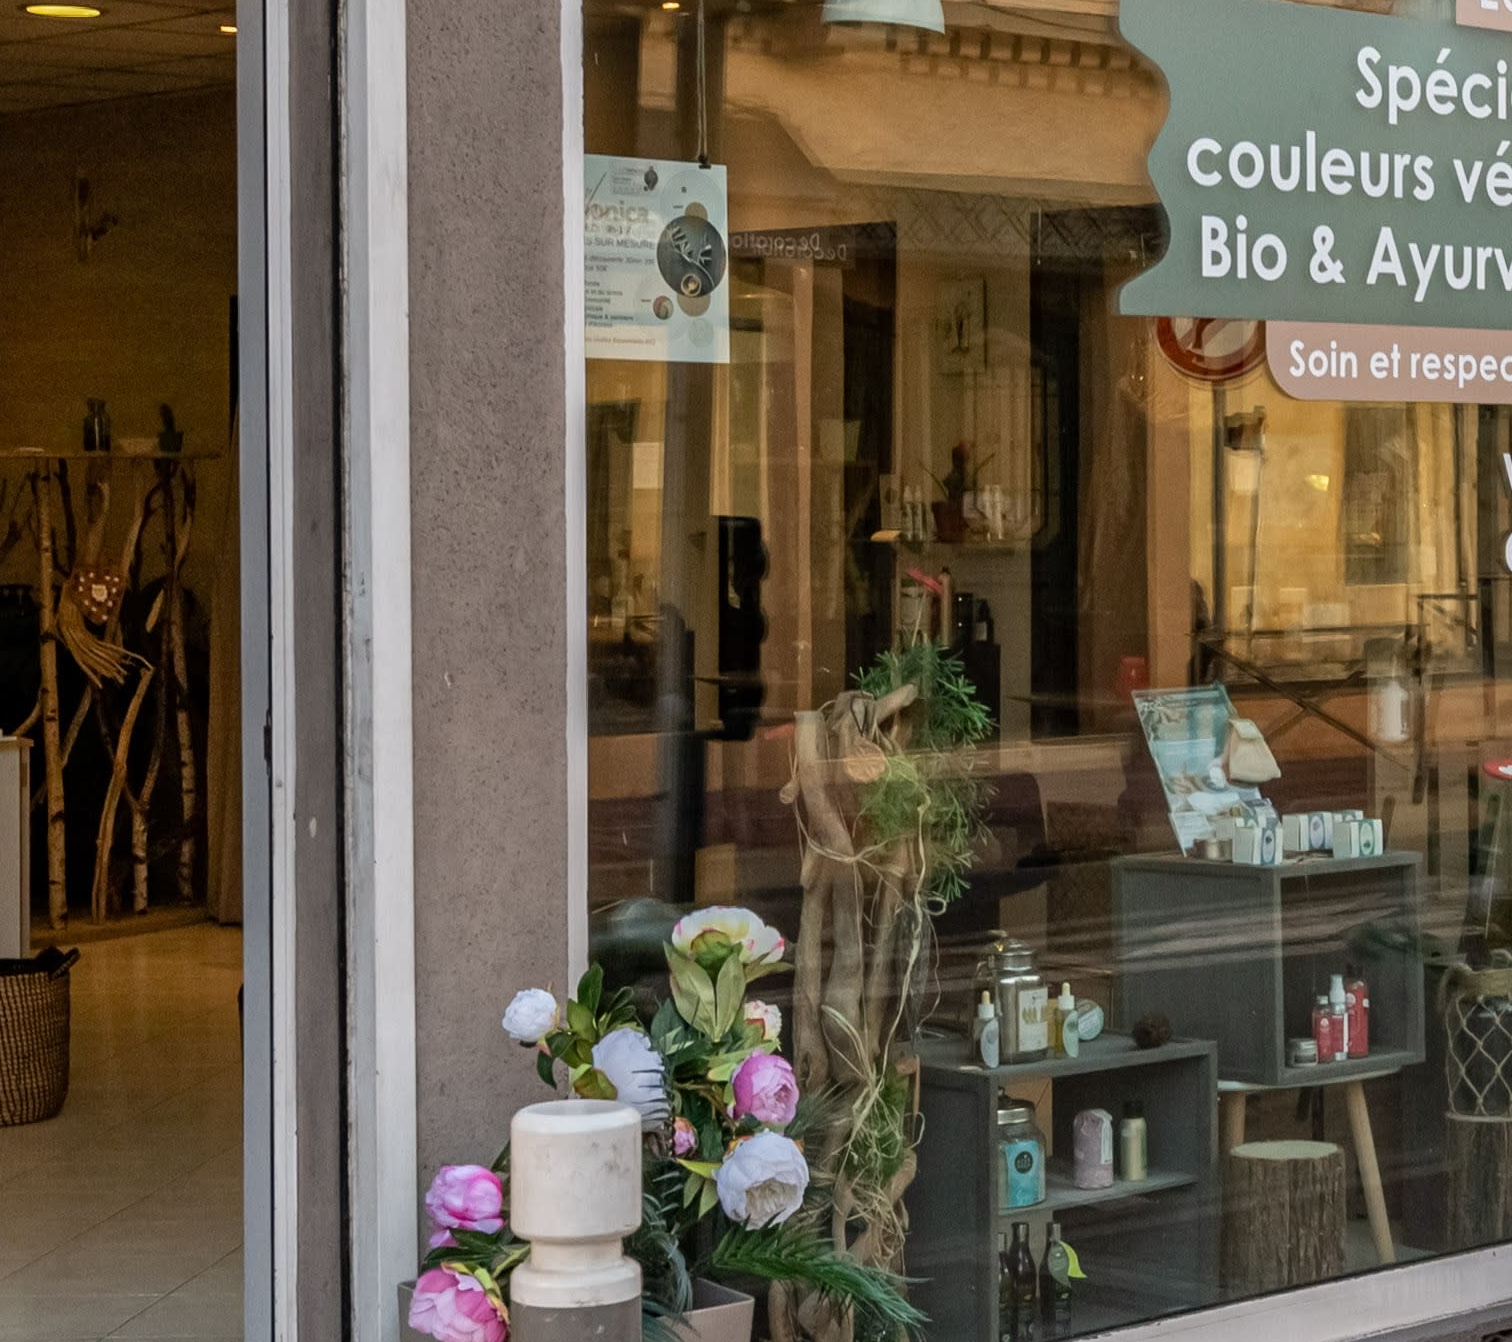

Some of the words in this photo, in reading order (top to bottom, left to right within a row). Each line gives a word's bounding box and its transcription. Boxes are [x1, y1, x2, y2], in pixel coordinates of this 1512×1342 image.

[1188, 130, 1435, 203] couleurs
[1201, 214, 1288, 282] Bio
[1309, 224, 1346, 285] &
[1290, 341, 1358, 378] Soin
[1370, 342, 1401, 379] et
